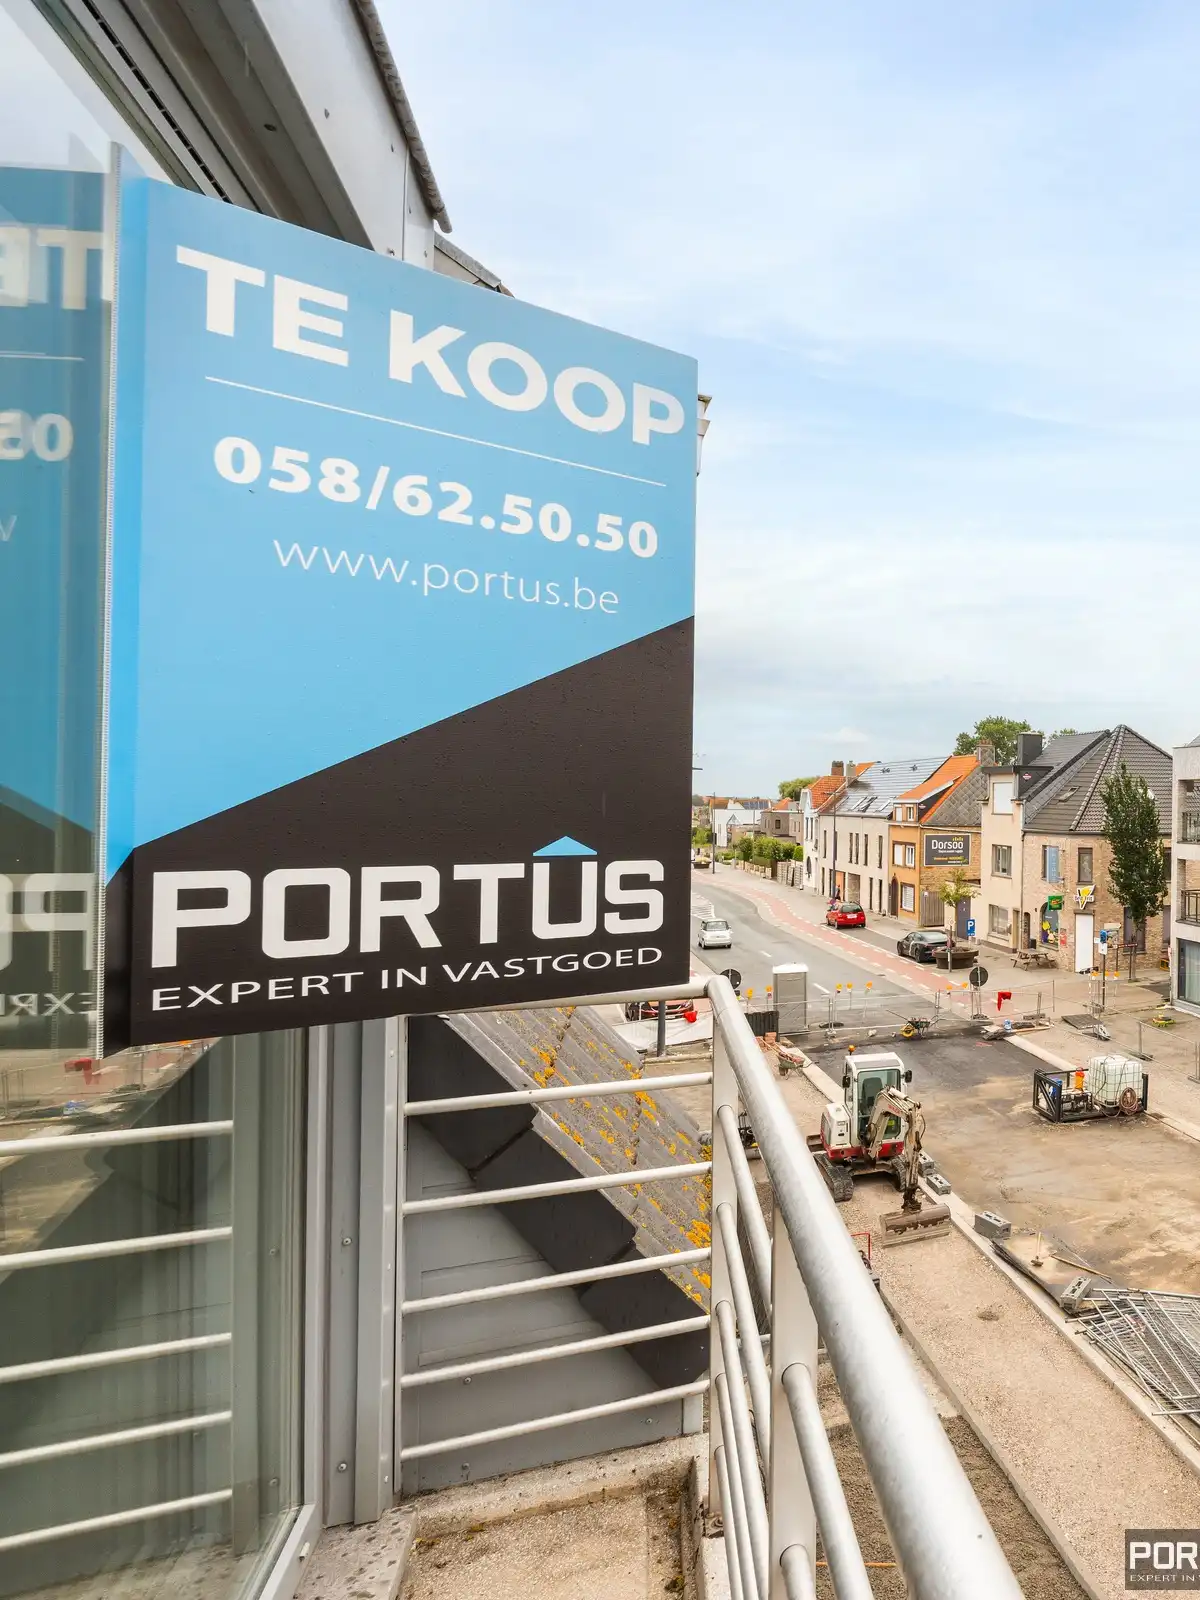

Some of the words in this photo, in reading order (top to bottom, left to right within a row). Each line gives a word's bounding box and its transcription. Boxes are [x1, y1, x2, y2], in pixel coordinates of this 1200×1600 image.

[176, 245, 349, 367] TE
[389, 309, 686, 446] KOOP
[213, 436, 659, 559] 058/62.50.50
[273, 539, 620, 615] www.portus.be
[151, 859, 666, 969] PORTUS
[152, 971, 364, 1011] EXPERT
[381, 965, 426, 989] IN
[441, 946, 664, 983] VASTGOED
